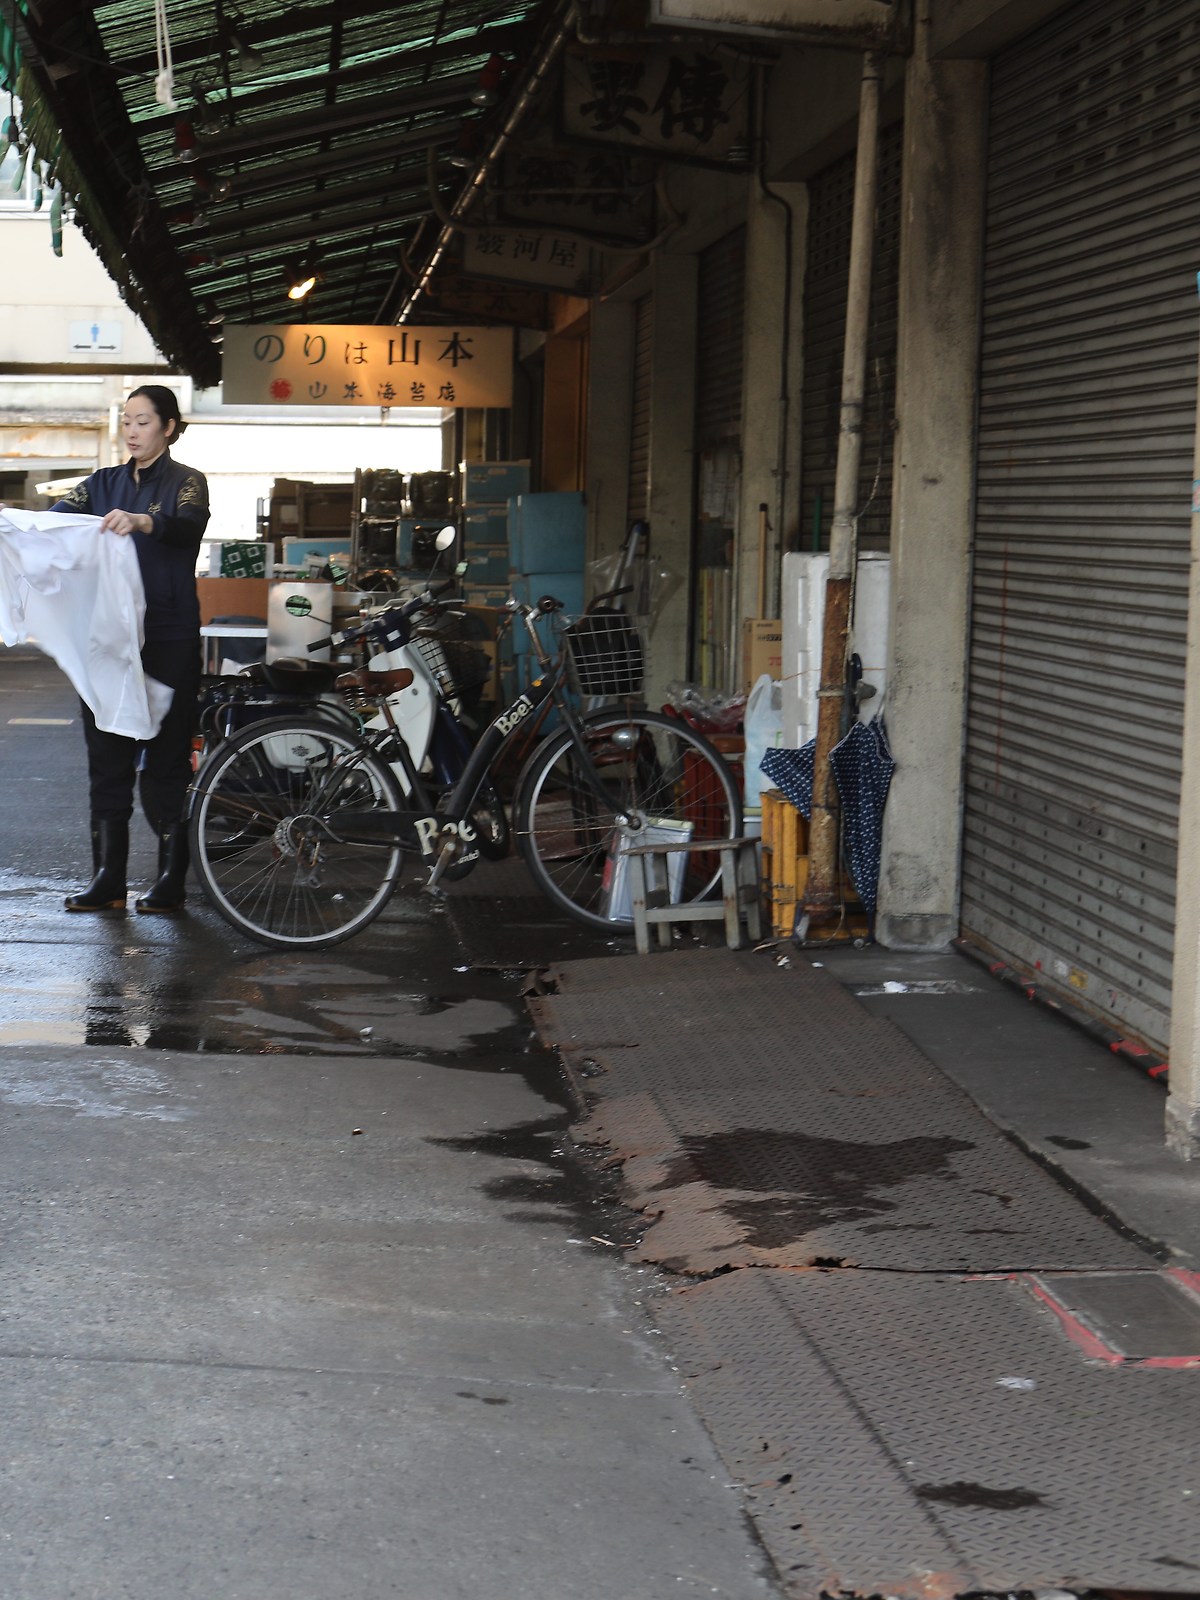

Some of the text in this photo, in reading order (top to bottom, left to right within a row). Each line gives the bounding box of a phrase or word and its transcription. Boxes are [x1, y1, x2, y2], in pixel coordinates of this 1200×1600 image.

[474, 231, 577, 269] 駿河屋
[253, 331, 474, 368] のりは山本
[308, 381, 457, 402] 山本海苔店
[493, 694, 535, 737] Bee!
